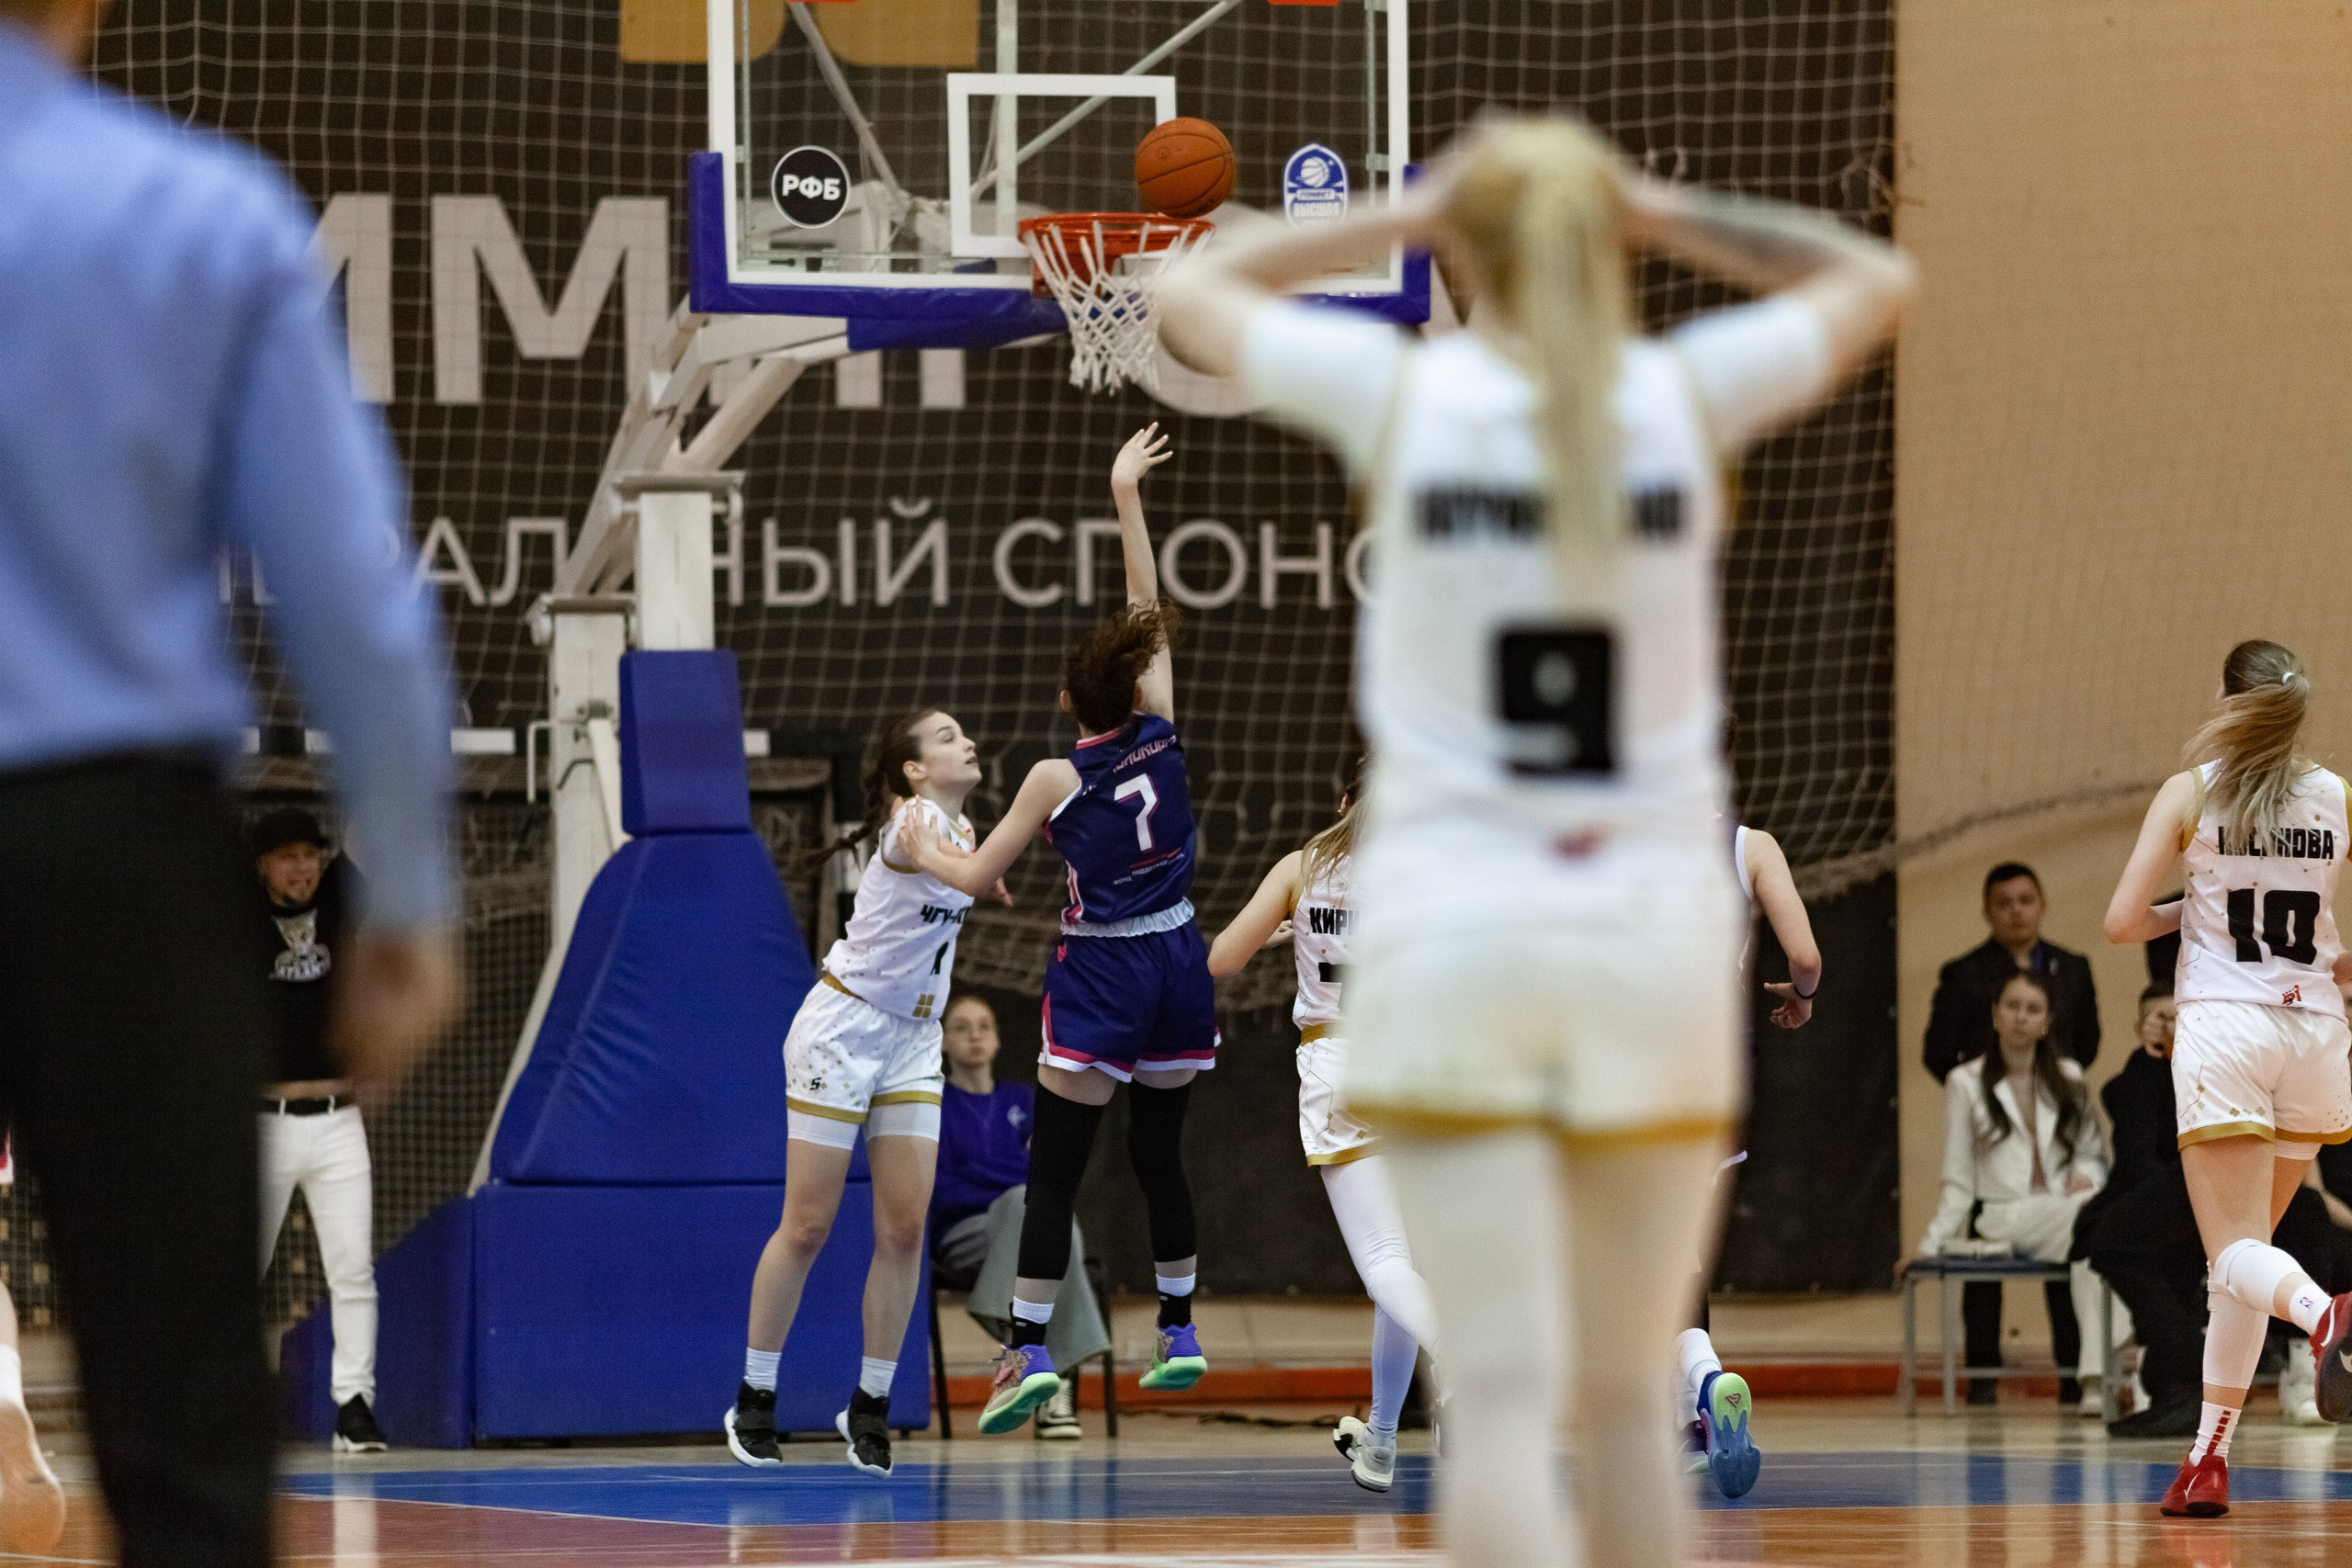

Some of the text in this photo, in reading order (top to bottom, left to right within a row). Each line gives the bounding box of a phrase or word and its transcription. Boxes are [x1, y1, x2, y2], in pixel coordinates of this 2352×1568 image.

[781, 174, 841, 200] РФБ
[1494, 625, 1615, 777] 9
[1114, 773, 1159, 852] 7
[1309, 907, 1362, 936] КИРИ
[2227, 888, 2321, 964] 10
